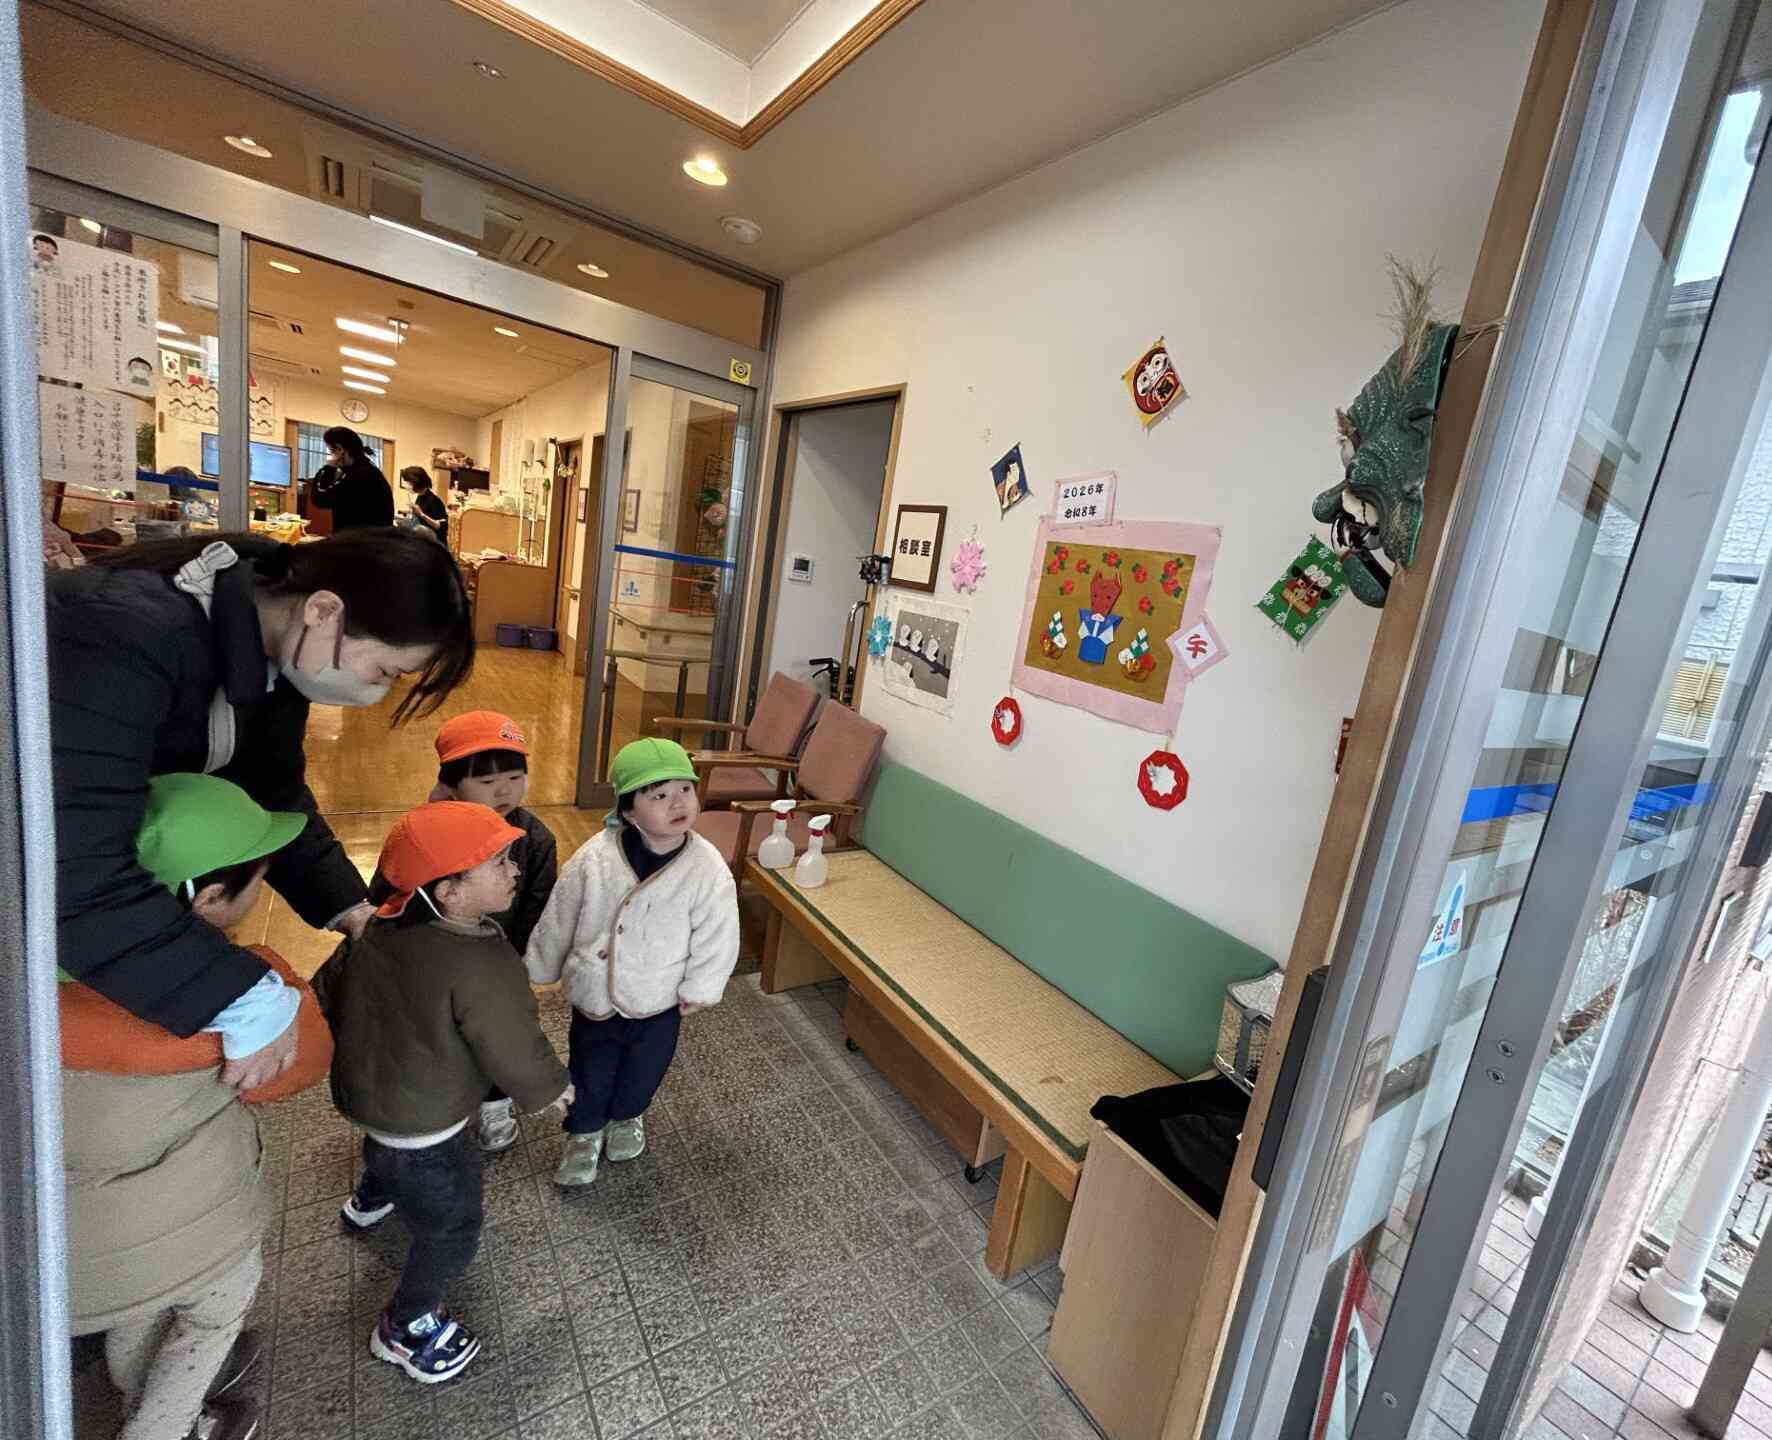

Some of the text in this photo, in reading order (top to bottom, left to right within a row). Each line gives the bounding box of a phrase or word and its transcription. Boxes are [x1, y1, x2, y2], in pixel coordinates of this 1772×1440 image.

[1063, 482, 1104, 499] 2026年
[1064, 505, 1097, 519] 令和8年
[899, 538, 931, 557] 相談室
[1186, 633, 1208, 659] 午
